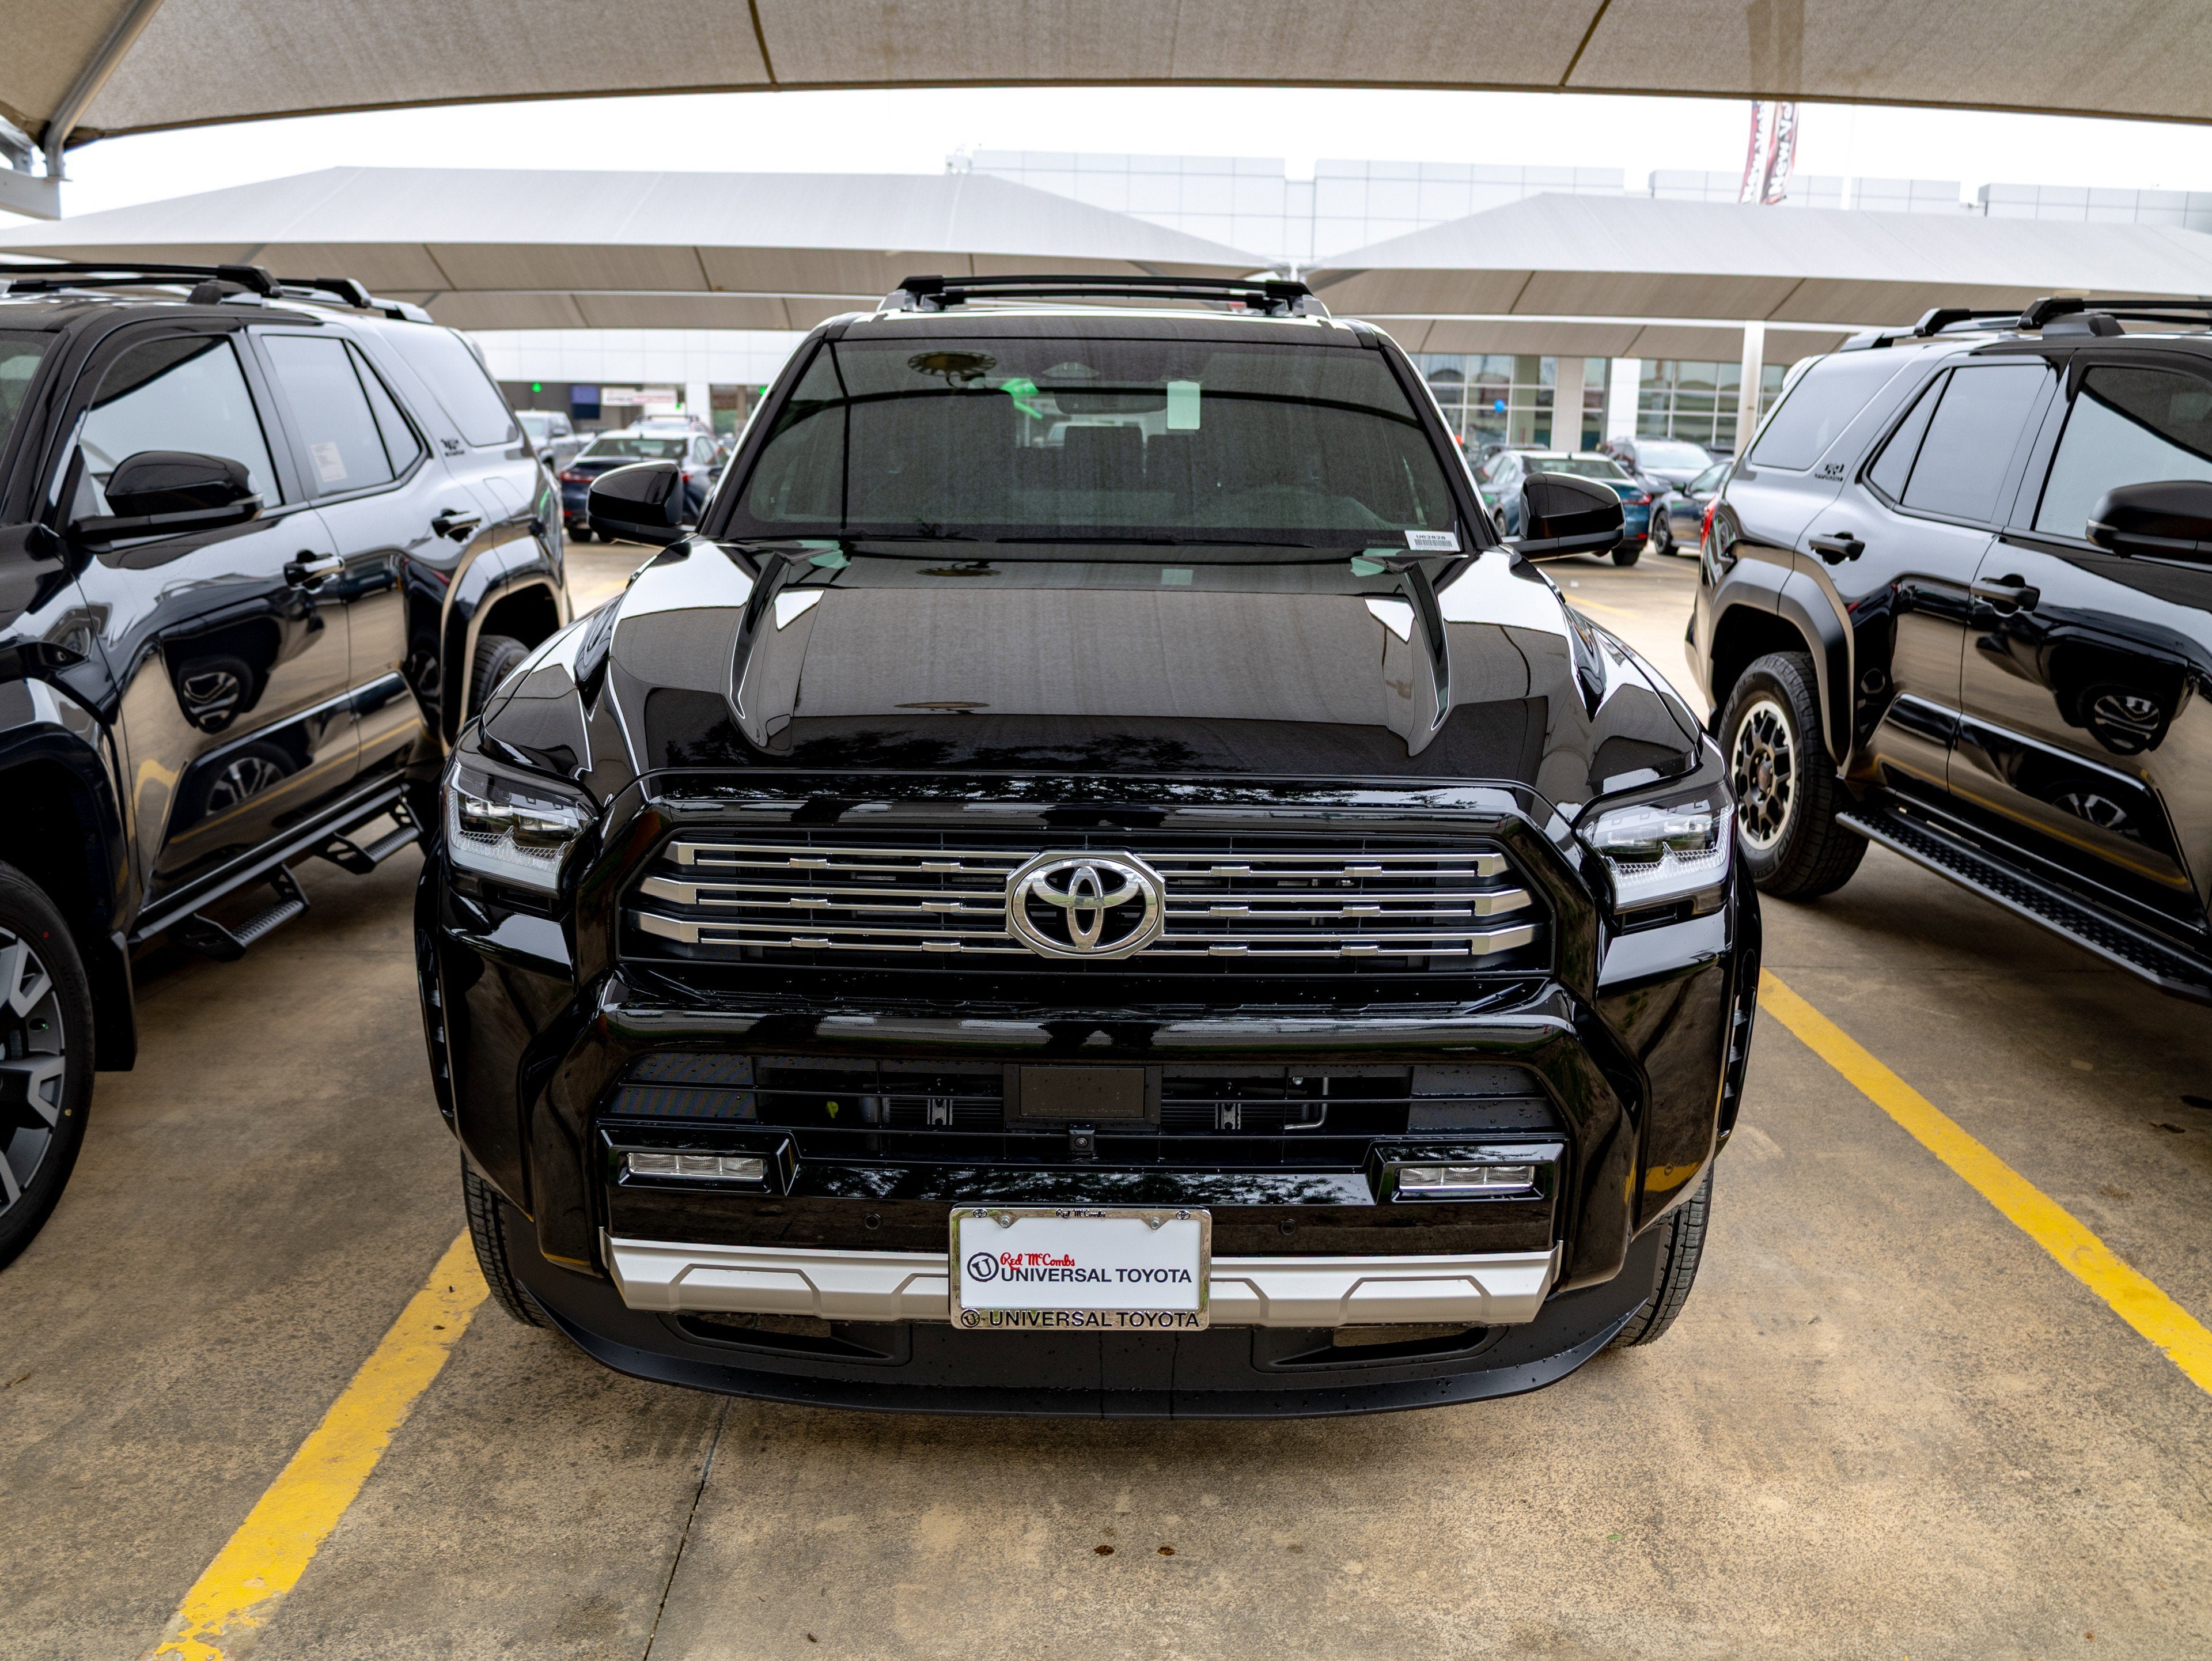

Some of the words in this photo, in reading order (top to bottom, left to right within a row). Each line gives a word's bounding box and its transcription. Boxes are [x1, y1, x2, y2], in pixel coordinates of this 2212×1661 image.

[1768, 142, 1790, 196] New
[1000, 1252, 1023, 1271] Red
[1024, 1253, 1075, 1267] McCombs
[1001, 1268, 1112, 1282] UNIVERSAL
[1115, 1269, 1192, 1283] TOYOTA
[989, 1311, 1113, 1327] UNIVERSAL
[1115, 1312, 1200, 1327] TOYOTA
